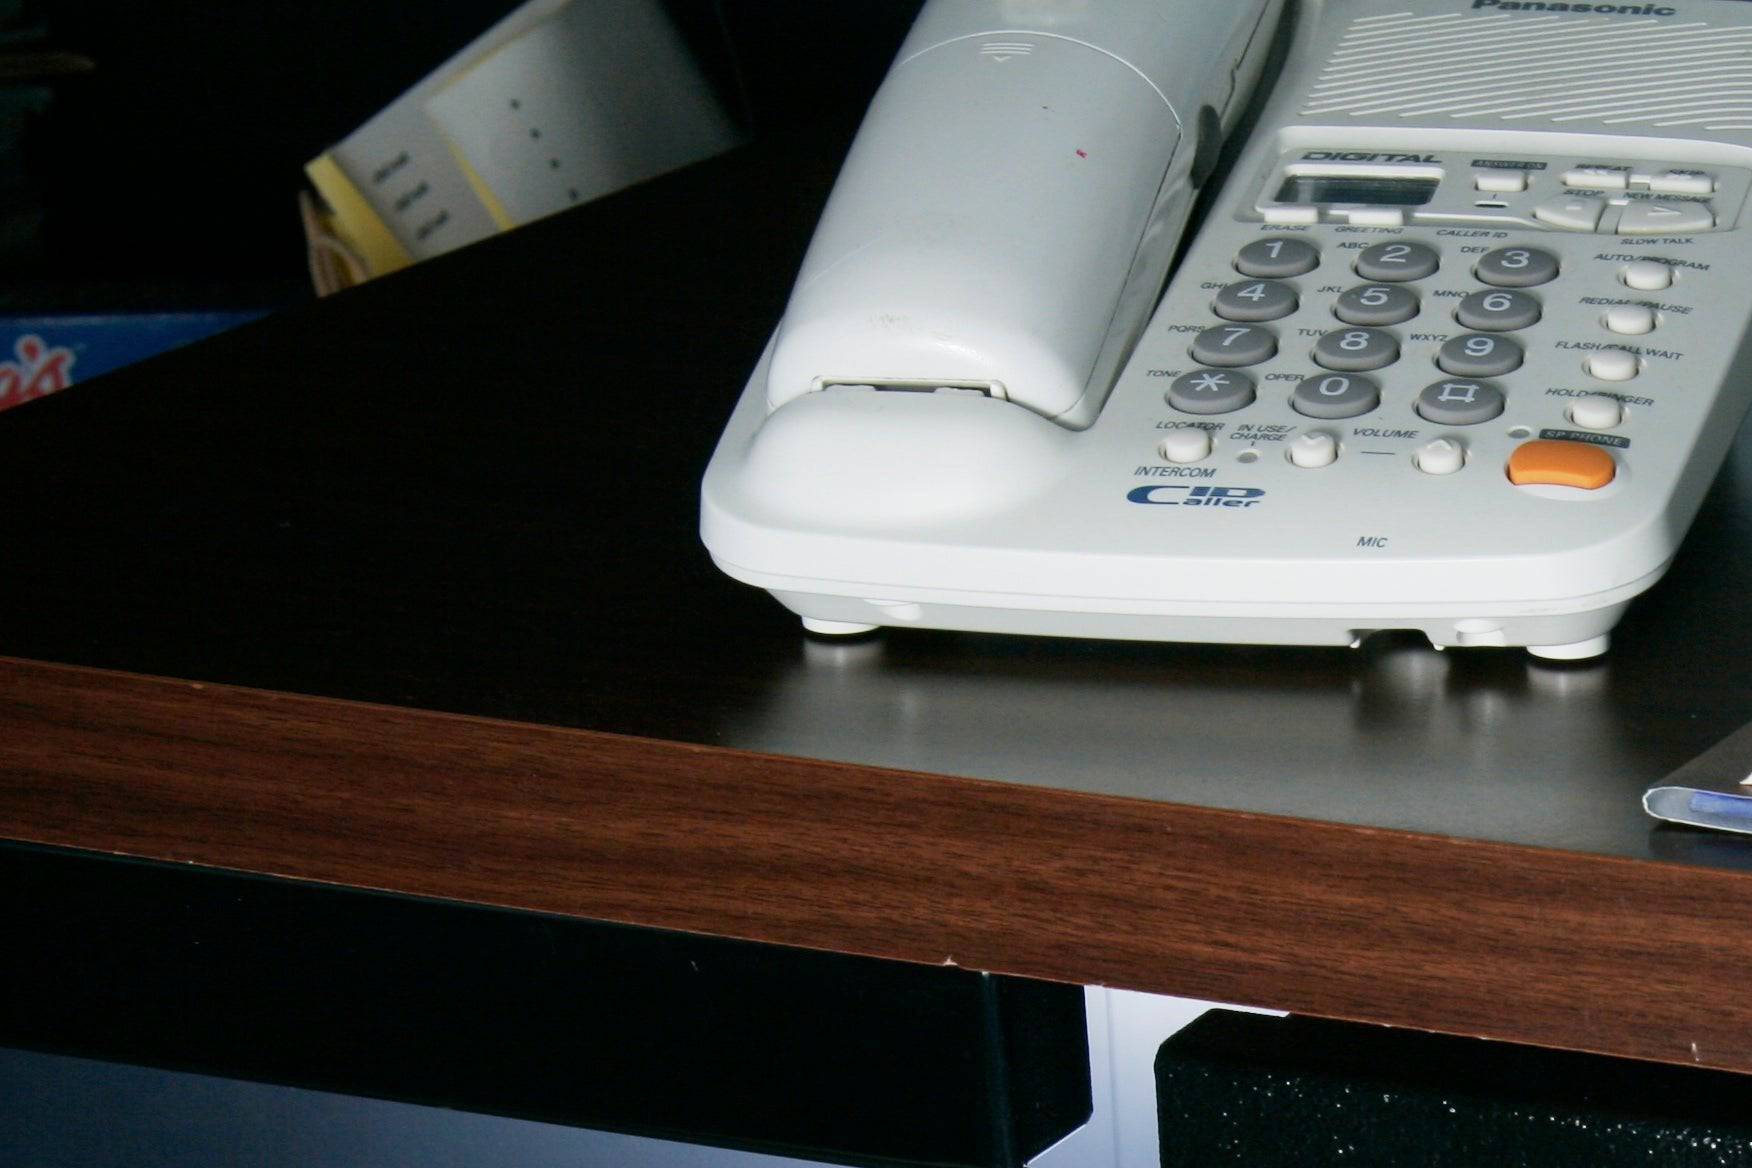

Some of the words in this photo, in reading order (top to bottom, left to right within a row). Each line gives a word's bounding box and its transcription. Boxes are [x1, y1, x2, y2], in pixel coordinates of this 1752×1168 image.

[1471, 0, 1677, 17] Panasonic
[1301, 151, 1443, 164] DIGITAL
[1562, 189, 1605, 198] STOP
[1261, 224, 1308, 232] ERASE
[1334, 226, 1405, 235] GREETING
[1436, 229, 1490, 238] CALLER
[1337, 241, 1369, 250] ABC
[1620, 237, 1660, 246] SLOW
[1663, 237, 1696, 246] TALK
[1265, 240, 1285, 259] 1
[1379, 244, 1412, 263] 2
[1460, 245, 1489, 254] DEF
[1500, 250, 1531, 269] 3
[1236, 282, 1266, 302] 4
[1316, 285, 1344, 294] JKL
[1359, 286, 1391, 306] 5
[1481, 292, 1514, 312] 6
[1222, 327, 1252, 347] 7
[1297, 328, 1328, 337] TUV
[1409, 332, 1448, 342] WXYZ
[1339, 330, 1371, 350] 8
[1464, 337, 1496, 357] 9
[1645, 349, 1685, 361] WAIT
[1146, 369, 1182, 378] TONE
[1264, 373, 1304, 382] OPER
[1155, 420, 1225, 432] LOCATOR
[1230, 431, 1288, 442] CHARGE
[1352, 427, 1420, 440] VOLUME
[1570, 432, 1624, 448] PHONE
[1133, 465, 1217, 479] INTERCOM
[1356, 536, 1389, 549] MIC
